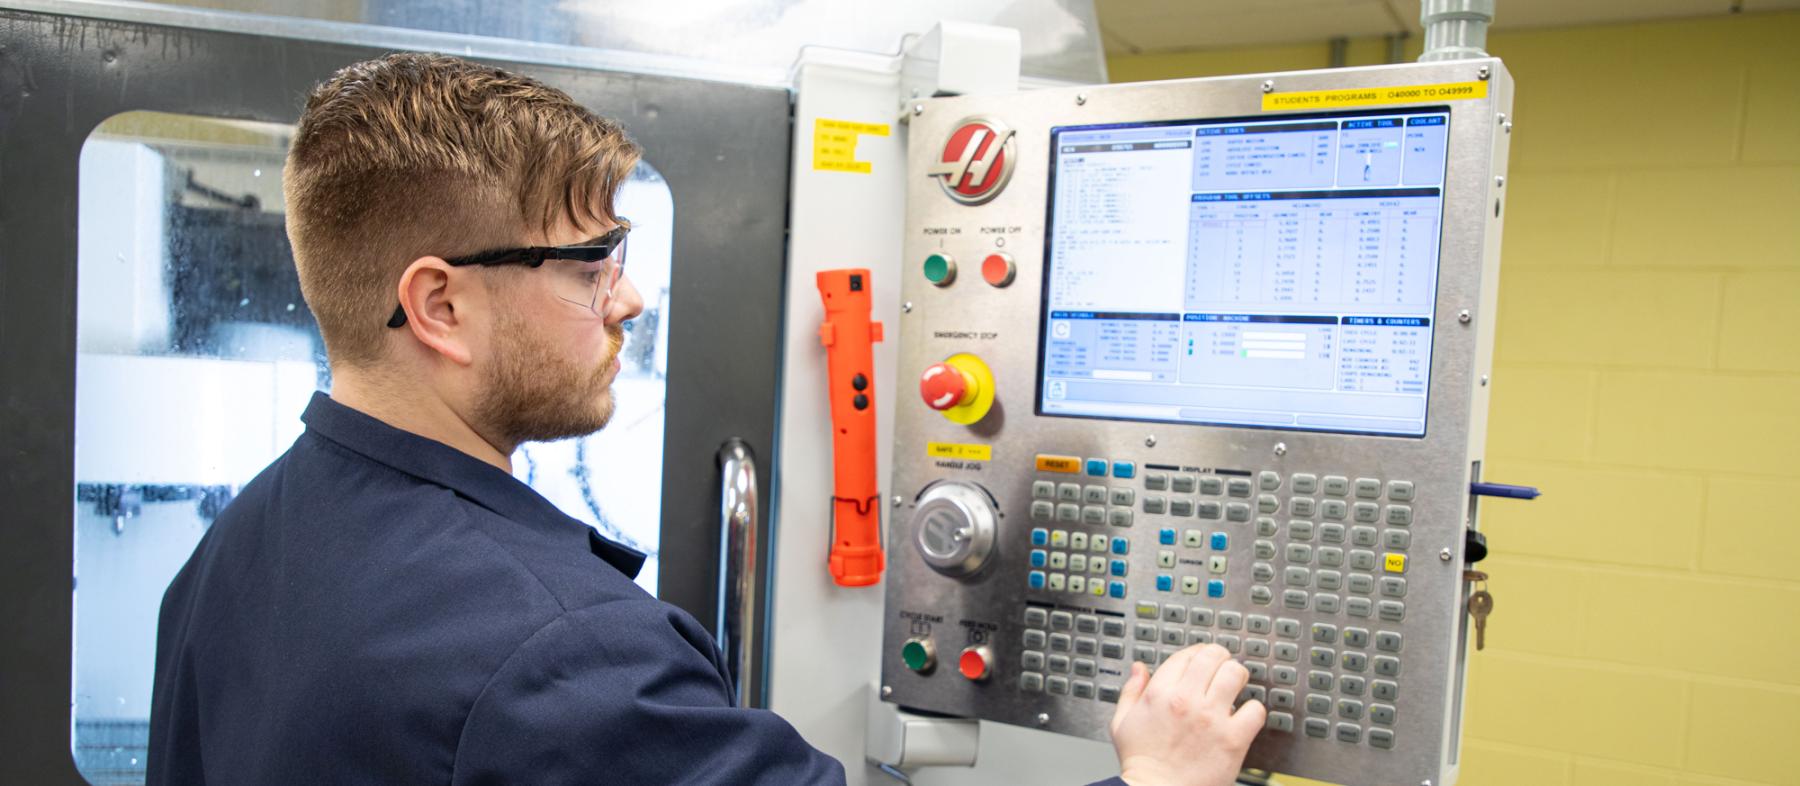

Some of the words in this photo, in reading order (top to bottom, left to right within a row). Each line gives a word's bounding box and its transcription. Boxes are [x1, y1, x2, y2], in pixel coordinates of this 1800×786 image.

[1273, 94, 1320, 105] STUDENTS
[1325, 92, 1377, 103] PROGRAMS
[1423, 88, 1437, 97] TO
[1347, 120, 1373, 128] ACTIVE
[1377, 119, 1395, 127] TOOL
[1410, 117, 1442, 125] COOLANT
[923, 227, 948, 235] POWER
[950, 227, 962, 235] ON
[980, 226, 1006, 234] POWER
[1008, 226, 1022, 234] OFF
[1348, 317, 1375, 325] TIMERS
[1385, 318, 1421, 326] COUNTERS
[934, 331, 978, 340] EMERGENCY
[980, 332, 998, 340] STOP
[935, 460, 964, 470] HANDLE
[965, 462, 982, 471] JOG
[1045, 459, 1070, 469] RESET
[1182, 465, 1212, 474] DISPLAY
[1038, 486, 1048, 494] F1
[1179, 558, 1203, 566] CURSOR
[1388, 559, 1402, 567] NO
